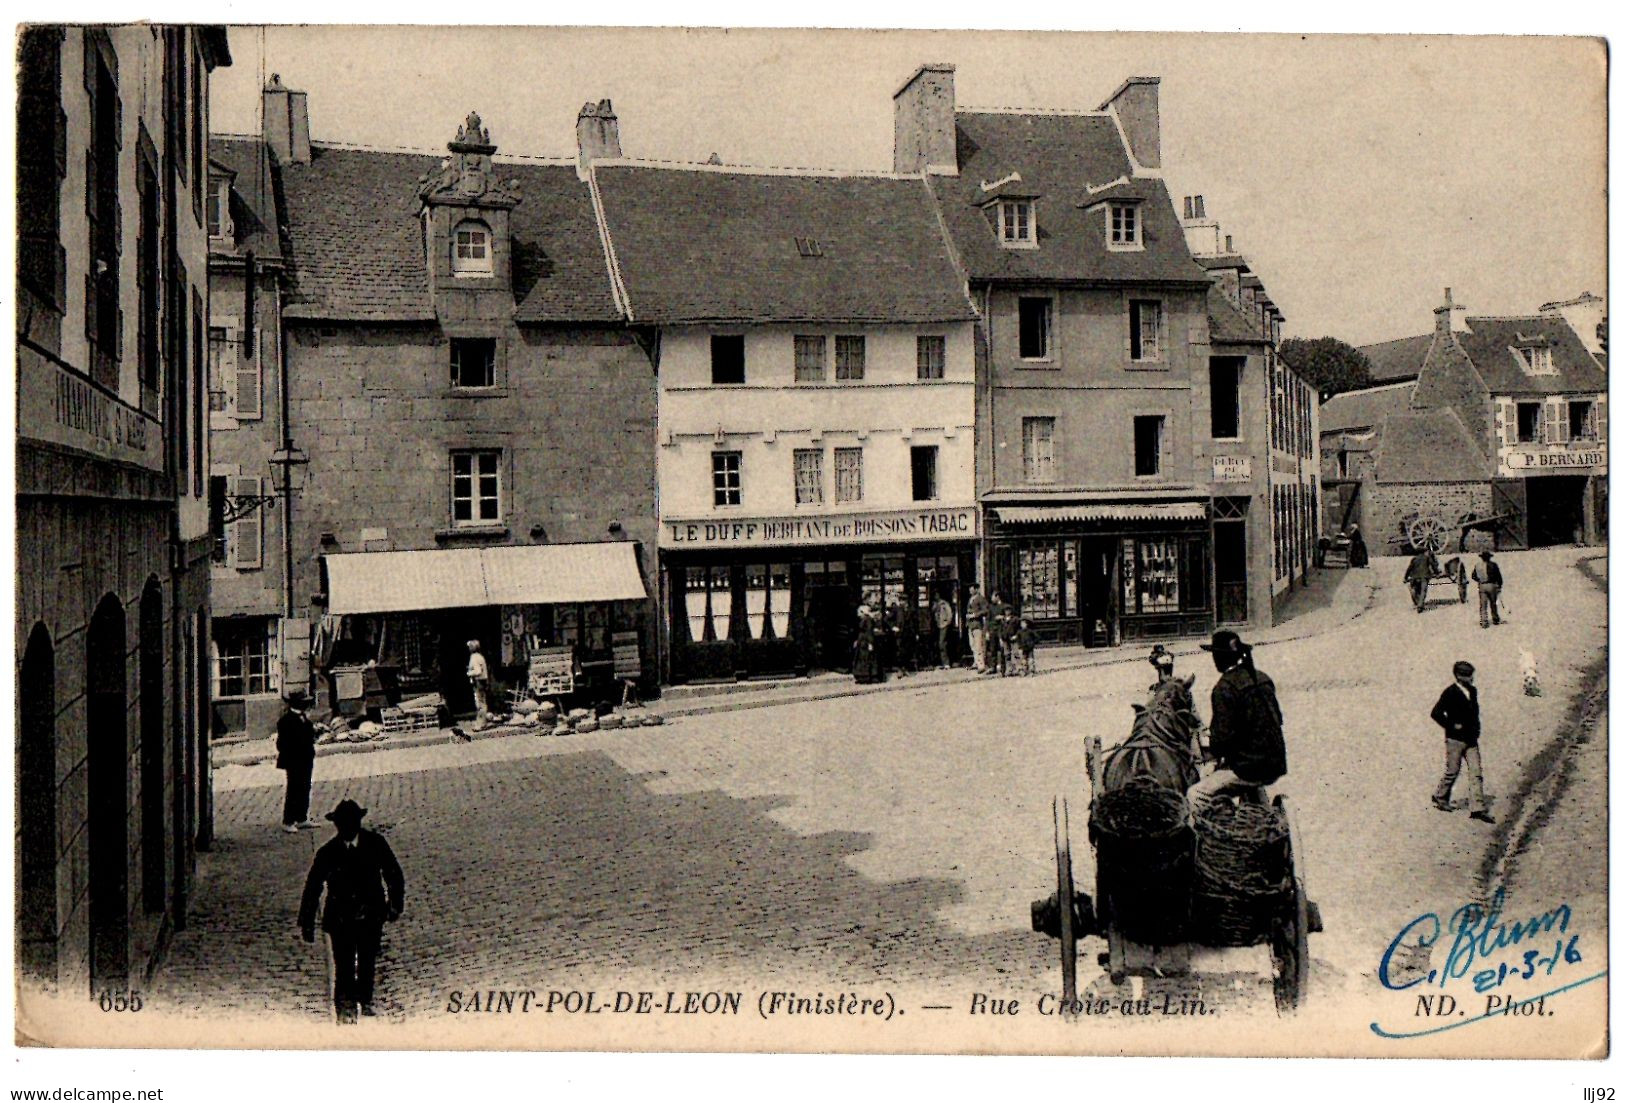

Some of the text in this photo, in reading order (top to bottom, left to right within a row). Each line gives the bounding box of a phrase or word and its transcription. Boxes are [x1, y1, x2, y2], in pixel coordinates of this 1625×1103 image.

[1539, 453, 1603, 466] BERNARD
[672, 525, 699, 542] LE
[705, 524, 758, 541] DUFF
[854, 518, 915, 537] BOISSONS
[919, 513, 968, 533] TABAC
[1378, 886, 1571, 990] C. Blum
